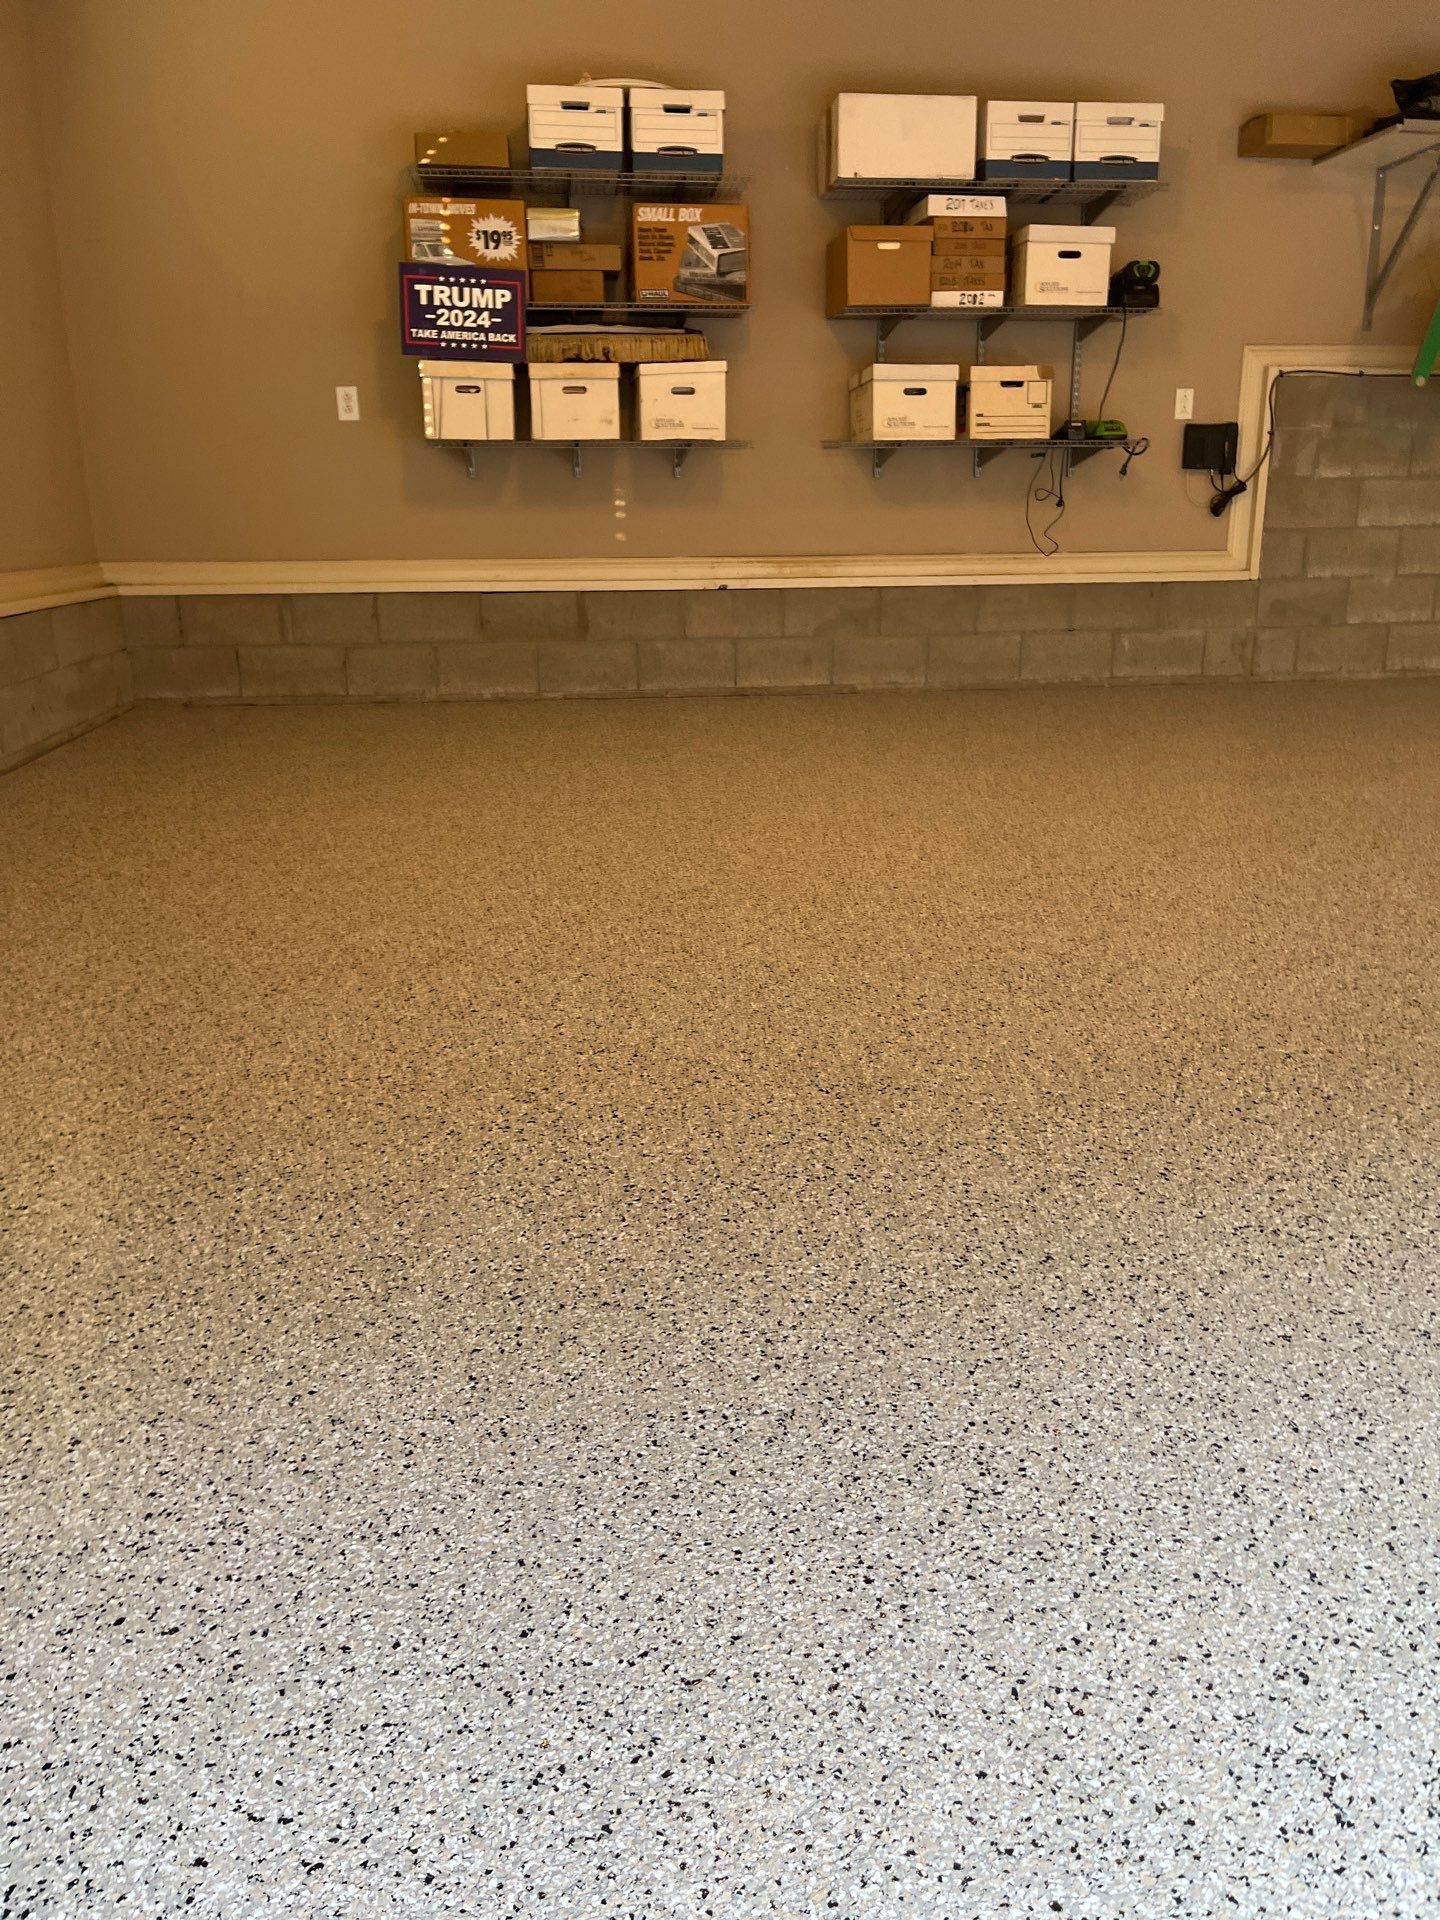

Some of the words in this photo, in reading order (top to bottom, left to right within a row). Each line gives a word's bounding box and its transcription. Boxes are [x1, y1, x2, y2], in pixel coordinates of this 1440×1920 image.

[637, 207, 675, 222] SMALL
[678, 208, 703, 222] BOX
[414, 284, 512, 309] TRUMP
[410, 329, 439, 339] TAKE
[440, 331, 486, 341] AMERICA
[488, 333, 517, 343] BACK
